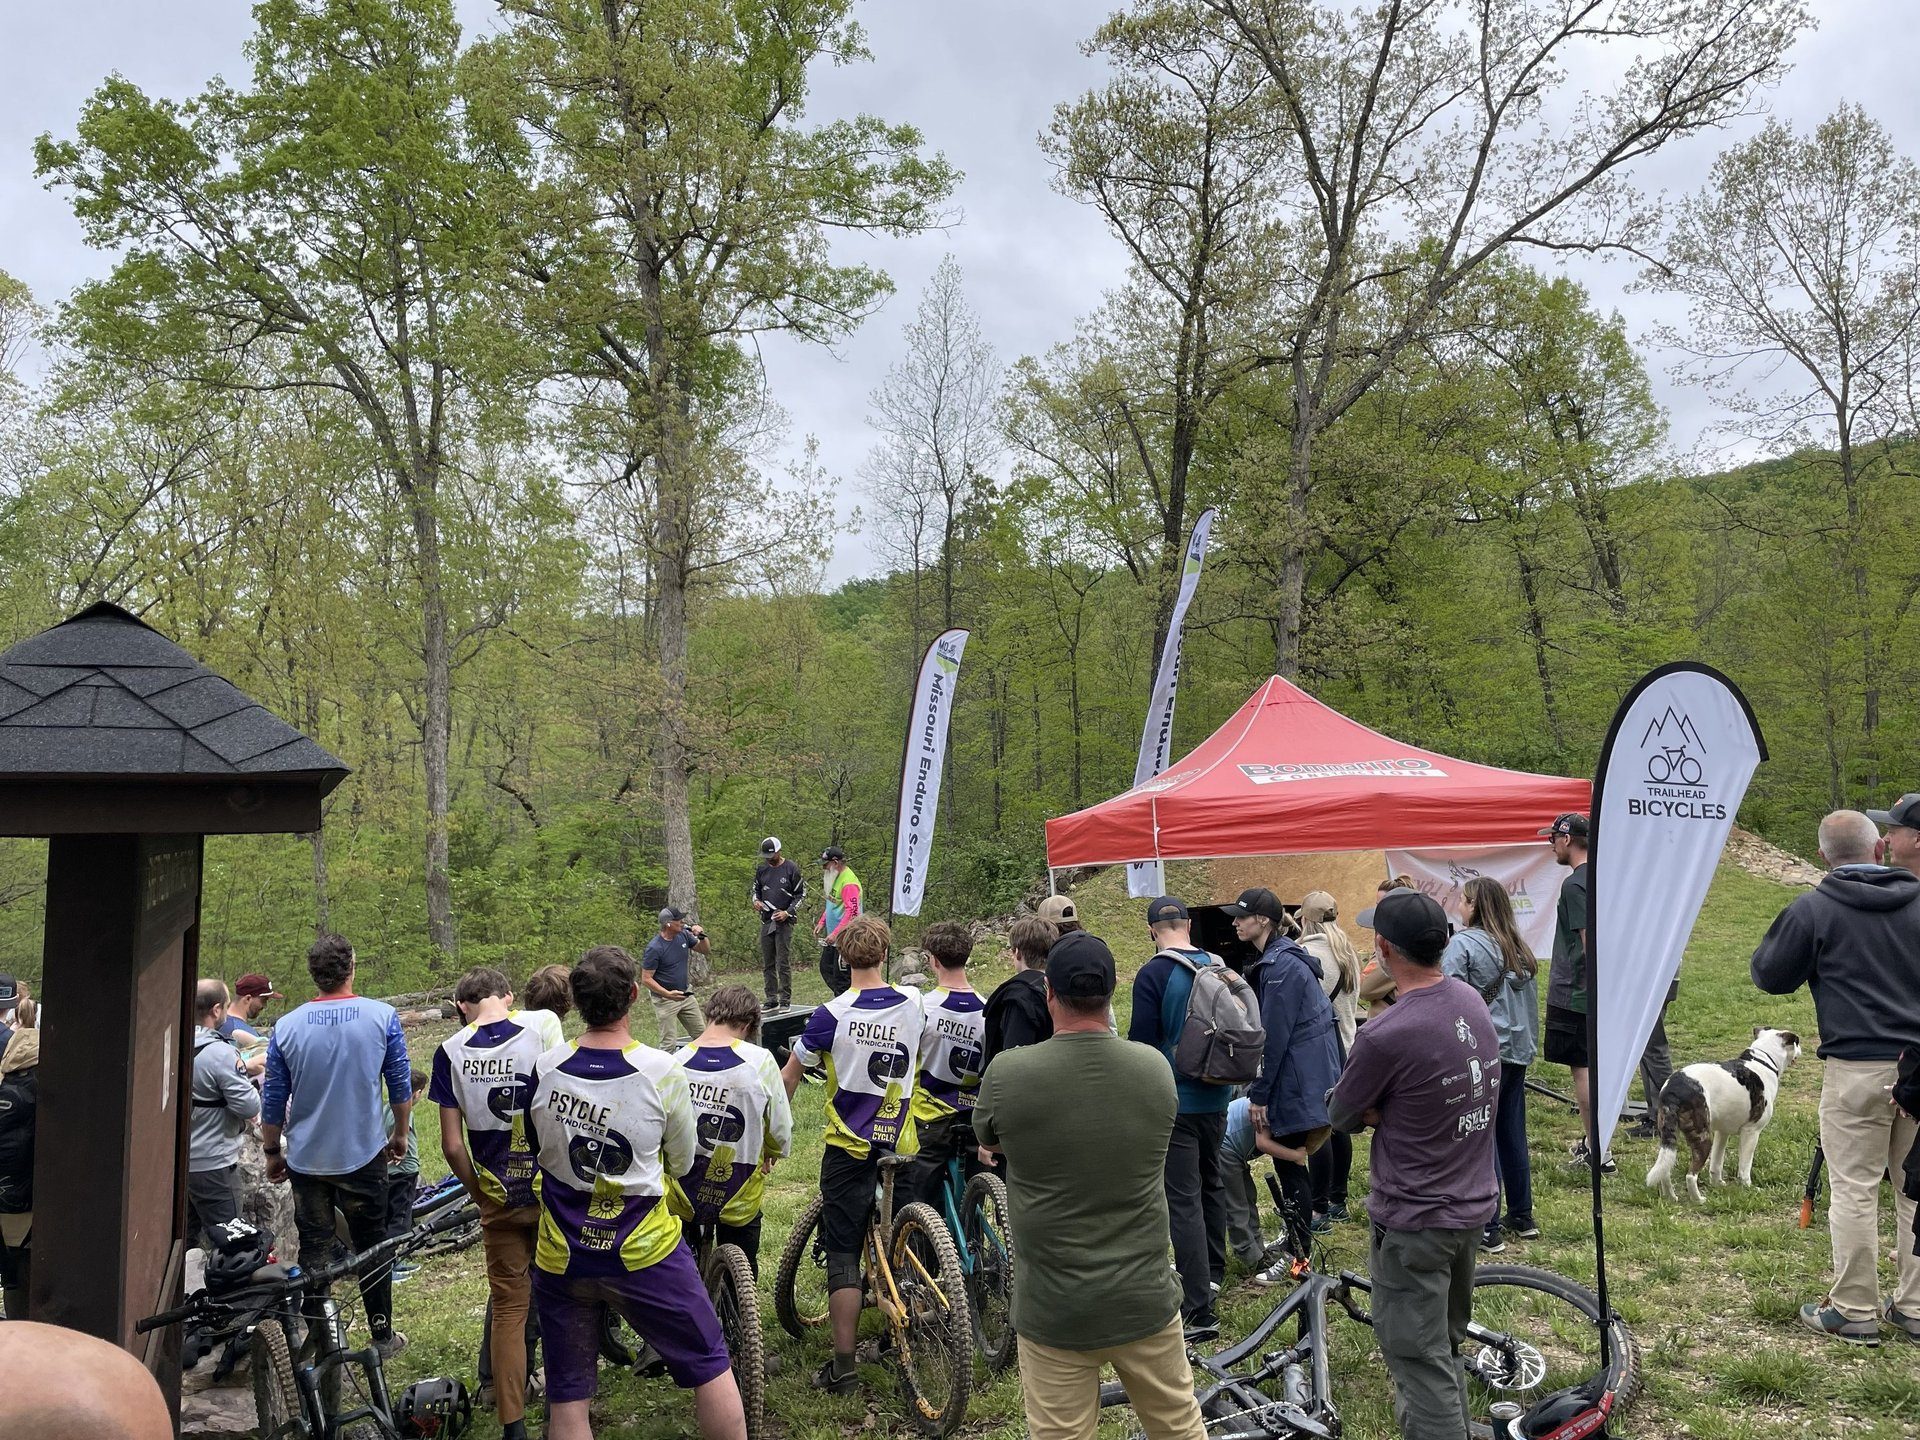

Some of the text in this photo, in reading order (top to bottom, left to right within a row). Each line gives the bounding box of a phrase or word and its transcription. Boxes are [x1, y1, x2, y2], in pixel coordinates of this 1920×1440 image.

[921, 672, 945, 754] Missouri
[910, 757, 932, 828] Enduro
[1647, 787, 1706, 799] TRAILHEAD
[1628, 798, 1727, 820] BICYCLES
[307, 1006, 359, 1026] DISPATCH
[849, 1021, 896, 1041] PSYCLE
[936, 1018, 977, 1040] PSYCLE
[856, 1038, 895, 1049] SYNDICATE
[942, 1033, 973, 1046] SYNDICATE
[462, 1058, 513, 1076] PSYCLE
[470, 1076, 514, 1084] SYNDICATE
[689, 1082, 729, 1104] SYCLE
[548, 1090, 611, 1127] PSYCLE
[555, 1114, 606, 1137] SYNDICATE
[506, 1168, 532, 1178] CYCLES
[580, 1236, 613, 1250] CYCLES
[581, 1226, 617, 1240] BALLWIN
